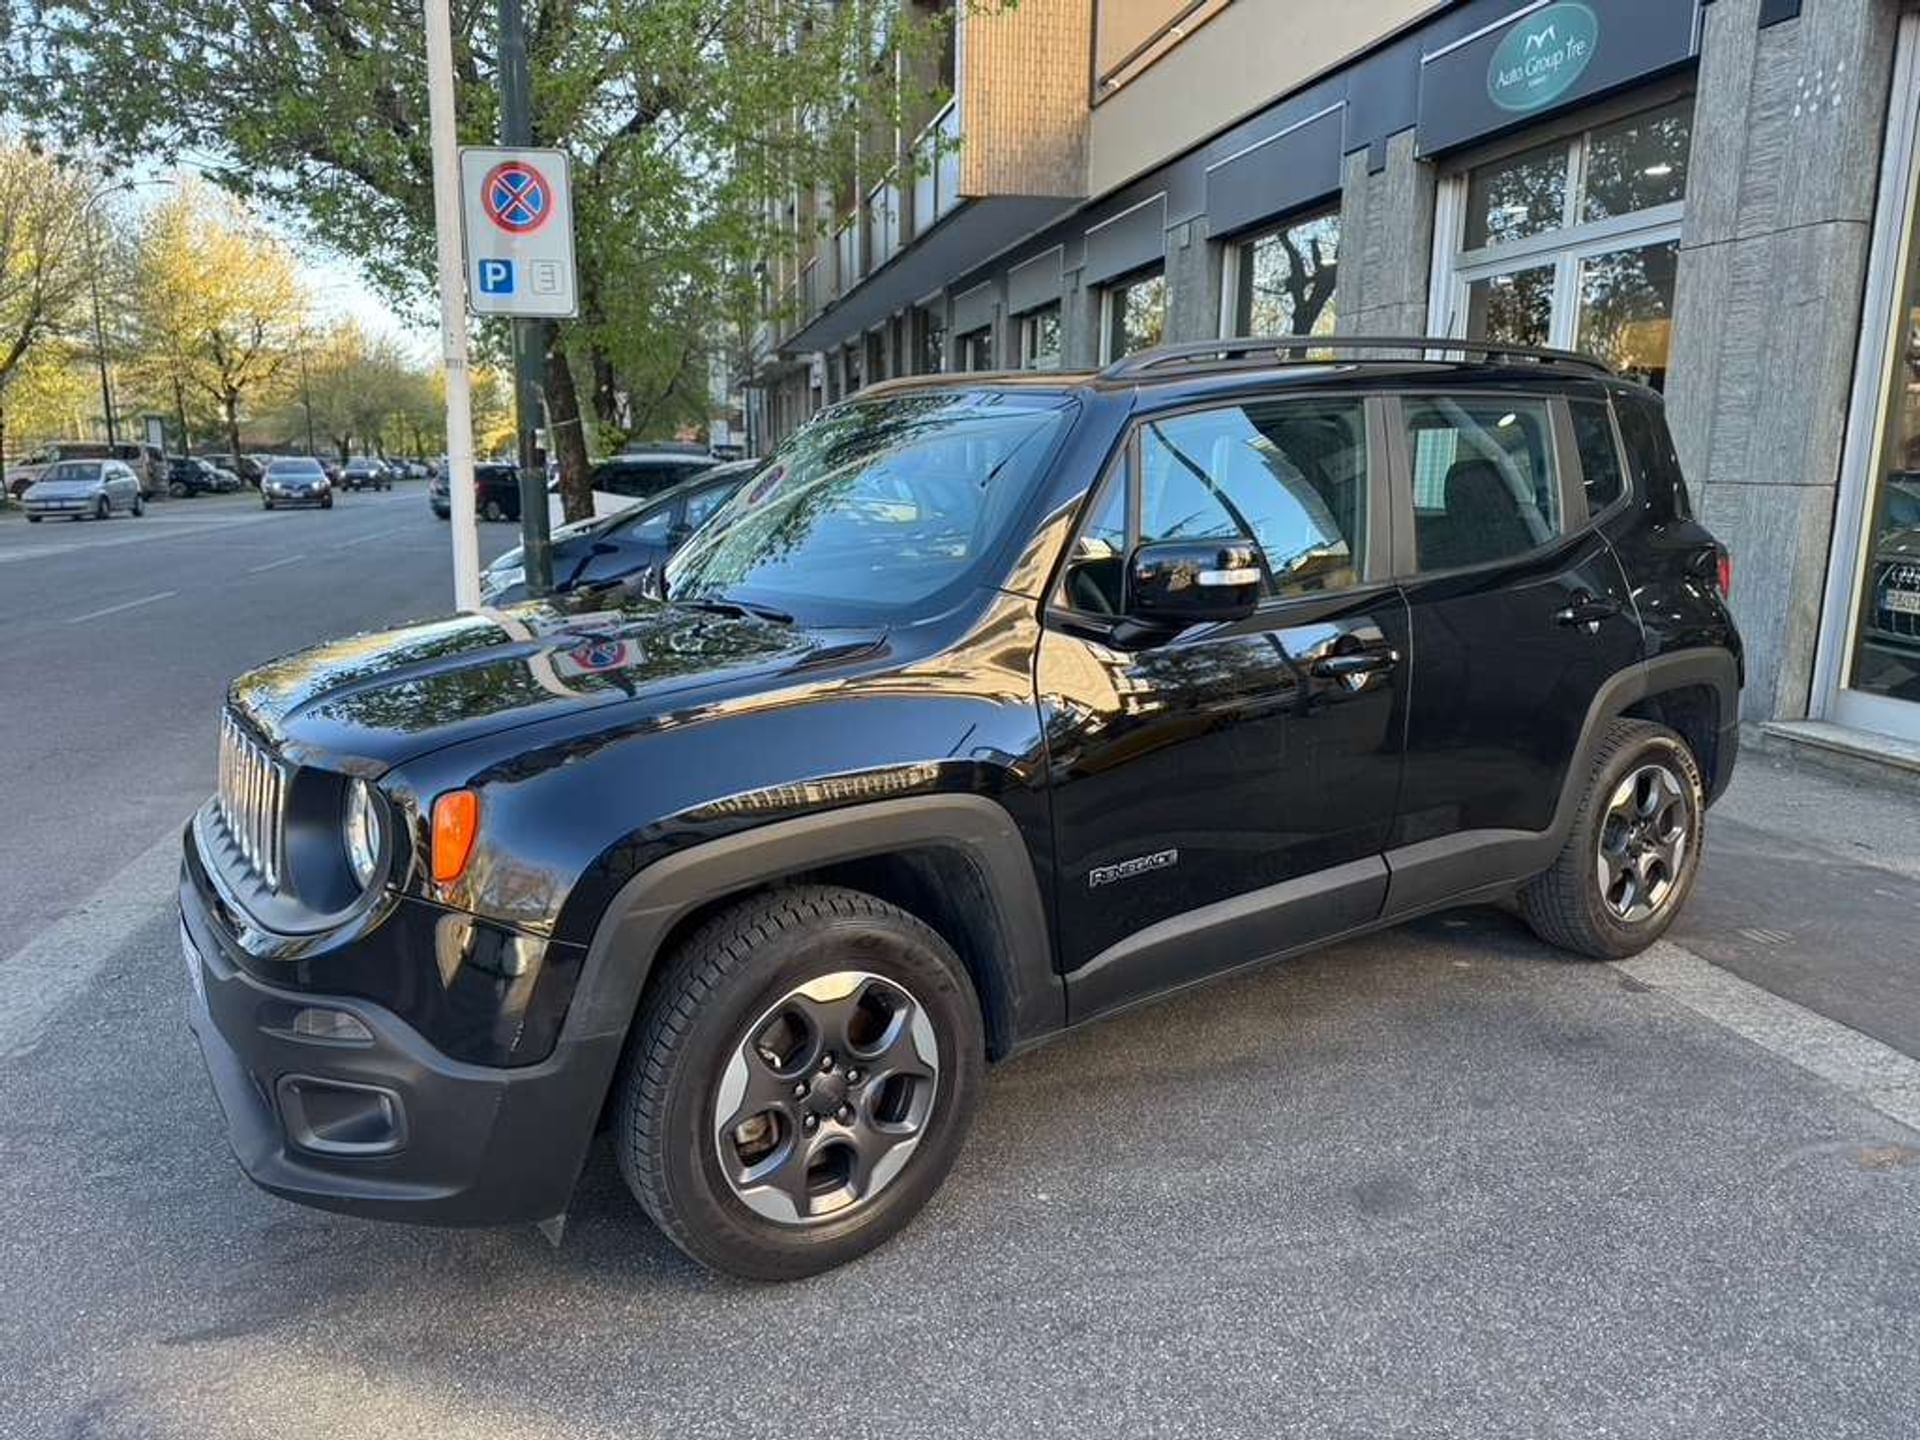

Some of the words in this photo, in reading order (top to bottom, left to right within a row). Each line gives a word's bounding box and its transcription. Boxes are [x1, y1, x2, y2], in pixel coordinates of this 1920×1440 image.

[1496, 66, 1524, 90] Auto
[1525, 50, 1564, 77] Group
[485, 262, 506, 291] P
